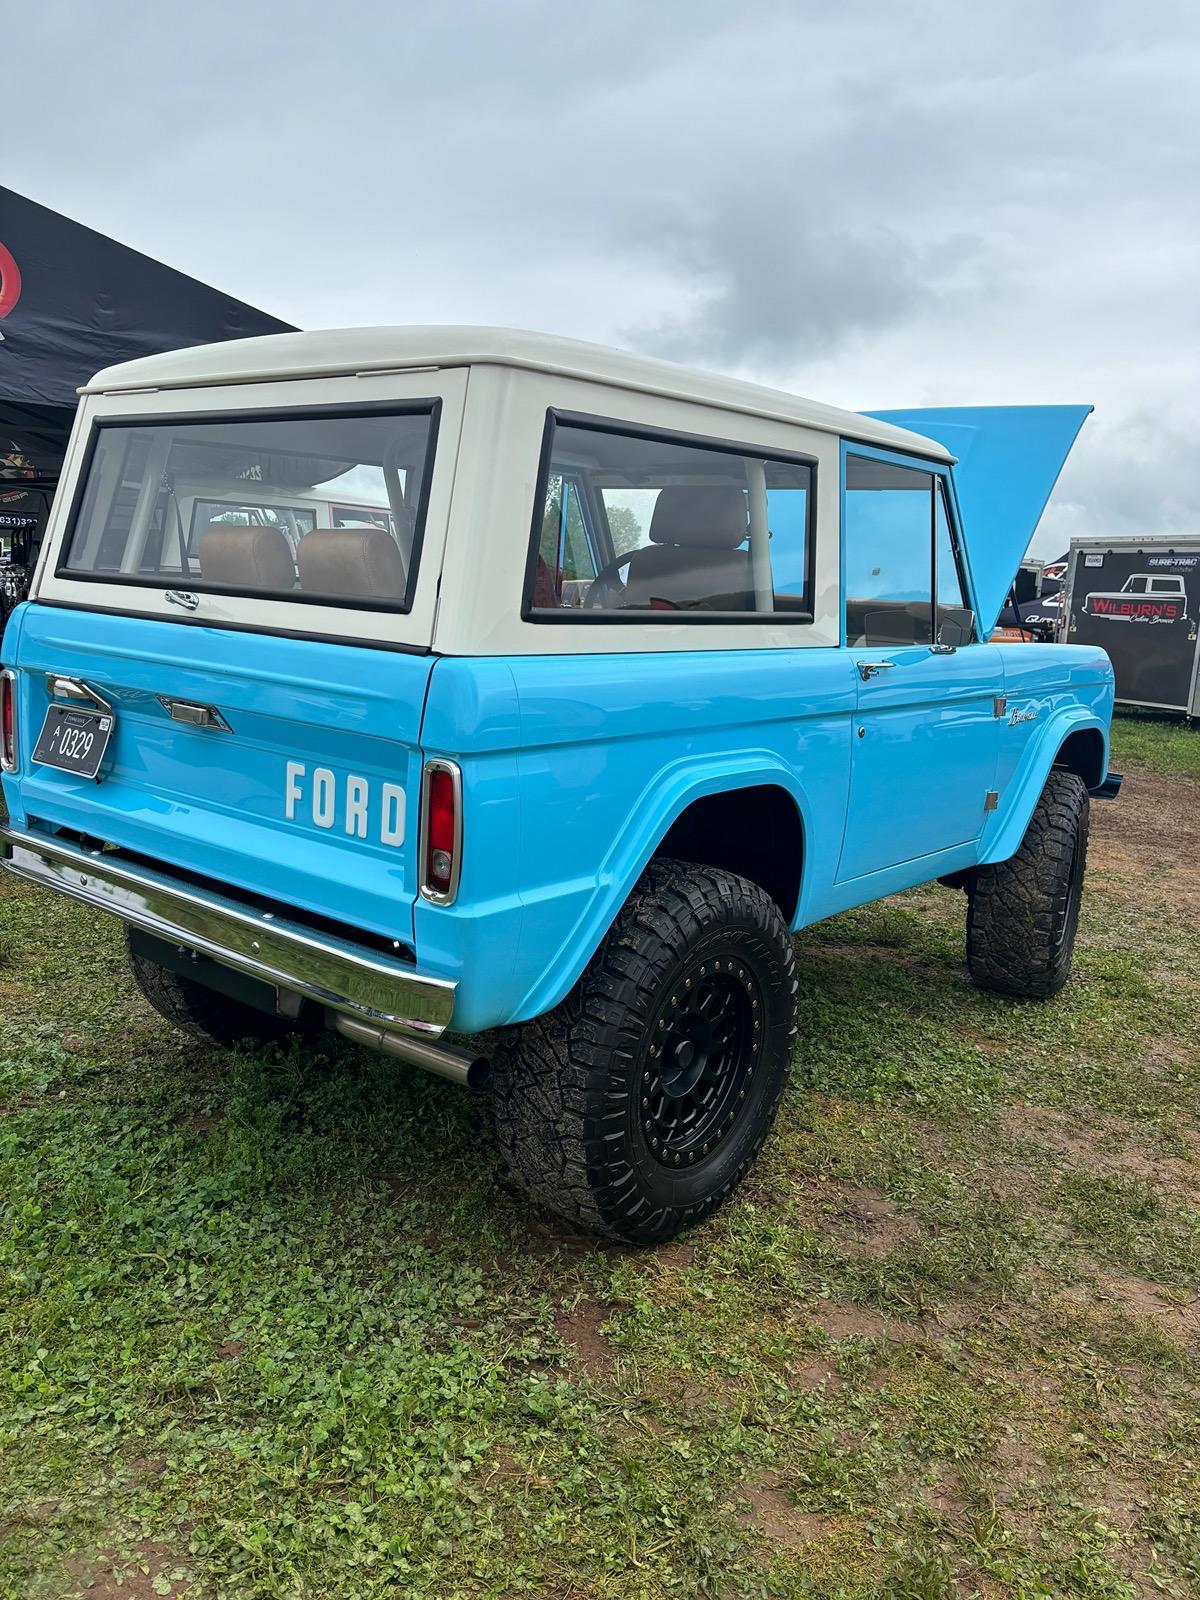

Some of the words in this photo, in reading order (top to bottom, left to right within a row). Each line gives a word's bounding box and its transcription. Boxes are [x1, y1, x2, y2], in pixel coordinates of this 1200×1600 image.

[1148, 558, 1198, 567] SURE-TRAC
[59, 727, 94, 760] 0329
[285, 761, 407, 847] FORD
